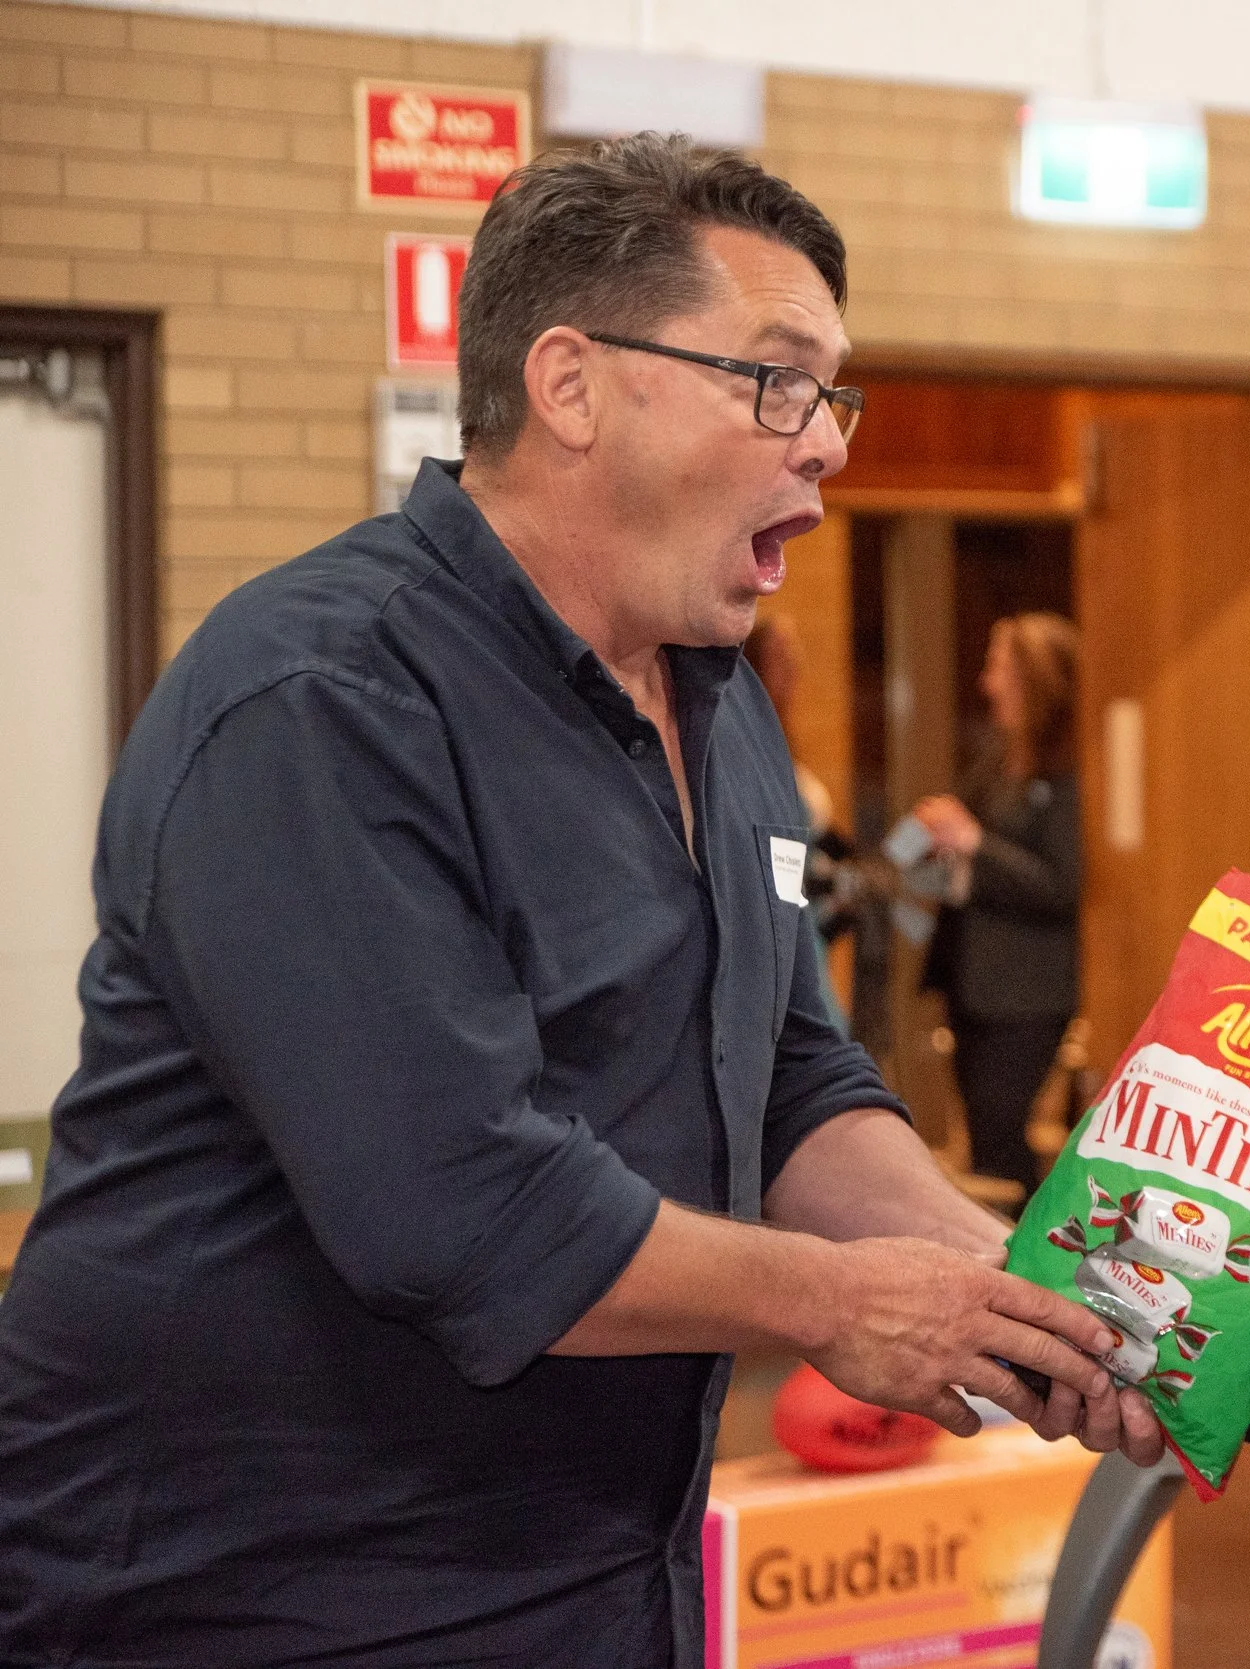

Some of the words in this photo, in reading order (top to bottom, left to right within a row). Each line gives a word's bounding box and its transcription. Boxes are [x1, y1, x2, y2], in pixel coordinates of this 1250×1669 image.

[440, 107, 495, 140] NO
[1153, 1068, 1202, 1095] moments
[1206, 1087, 1227, 1105] like
[1106, 1260, 1160, 1308] MINTIES
[746, 1519, 969, 1612] Gudair
